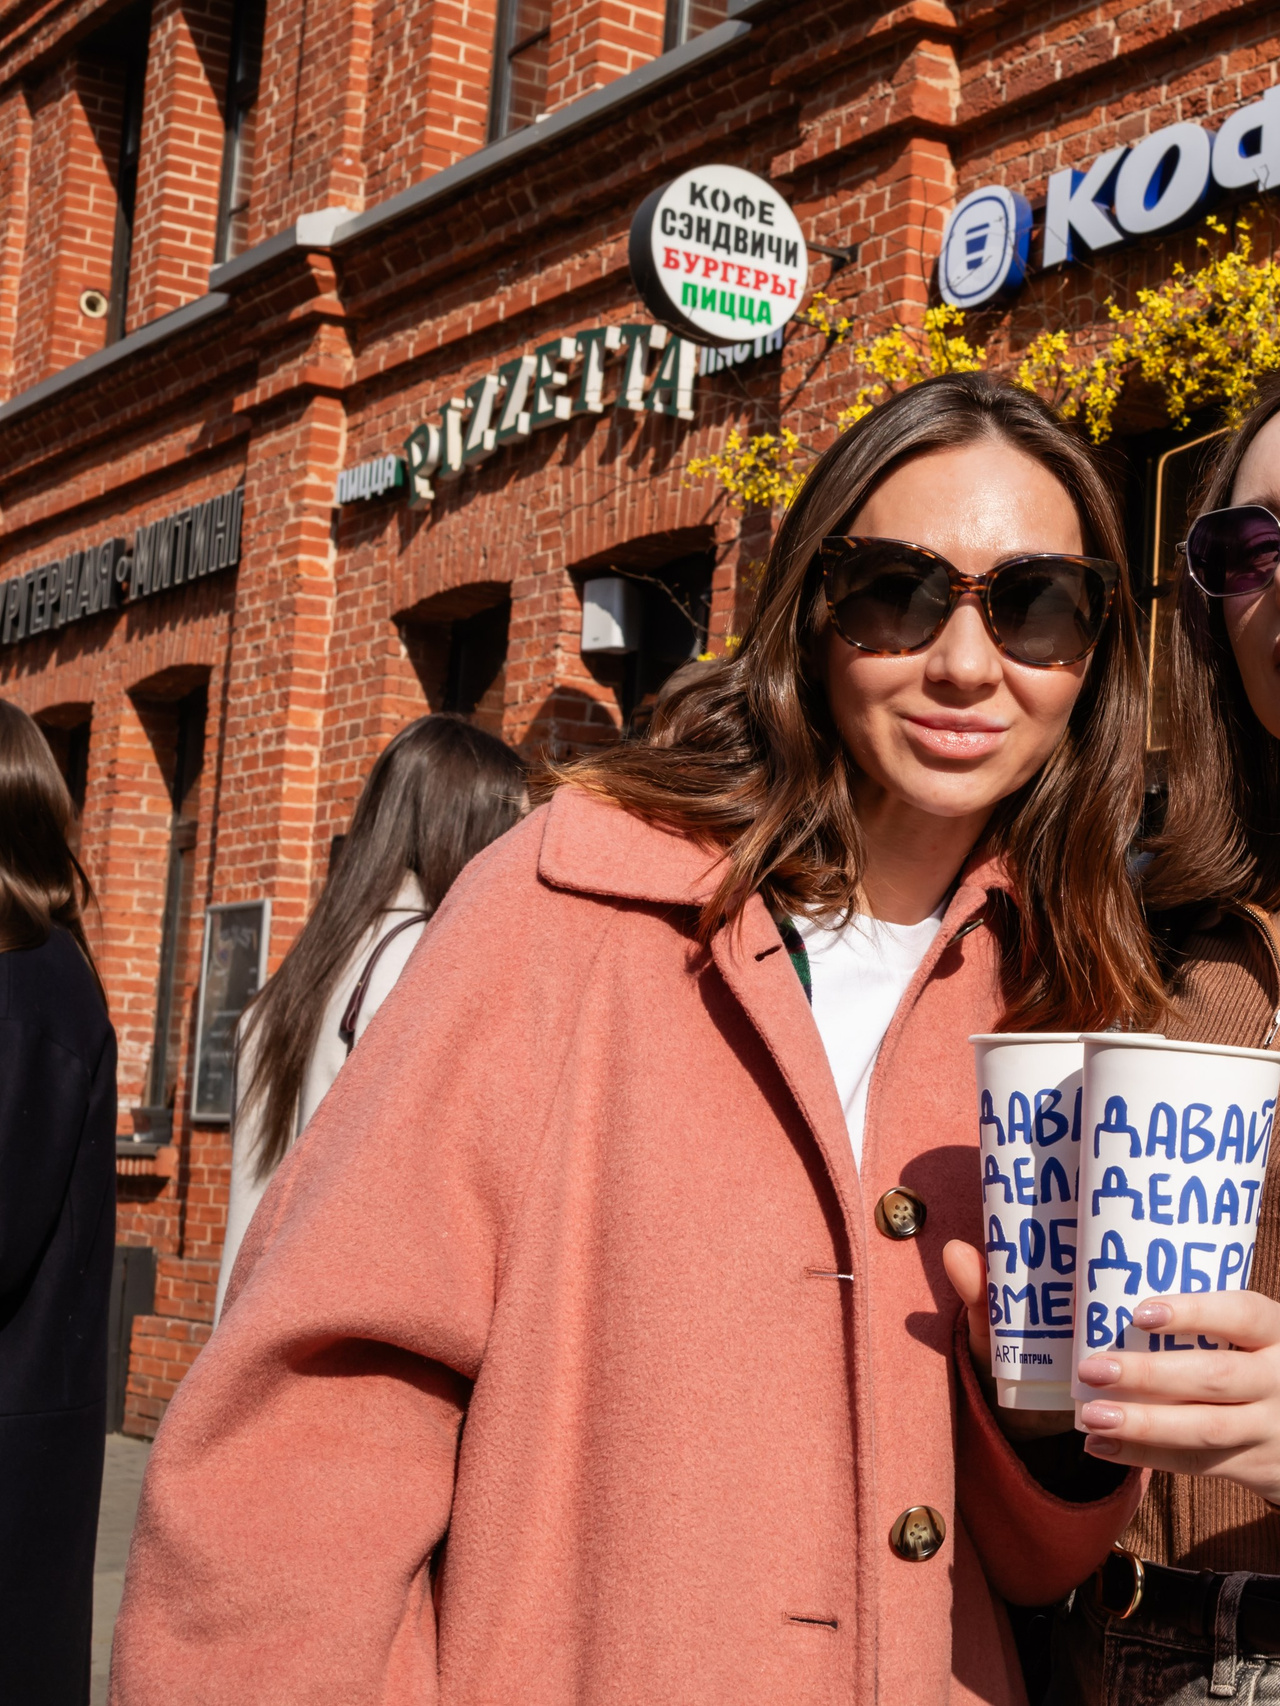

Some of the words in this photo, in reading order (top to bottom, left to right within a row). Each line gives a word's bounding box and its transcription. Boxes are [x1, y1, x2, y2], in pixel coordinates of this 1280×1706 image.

[690, 181, 775, 227] КОФЕ
[660, 208, 798, 268] СЭНДВИЧИ
[663, 246, 797, 300] БУРГЕРЫ
[681, 281, 772, 326] ПИЦЦА
[404, 323, 698, 509] PIZZETTA
[335, 453, 397, 503] ПИЦЦА
[130, 486, 245, 600] МИТИНГ
[1093, 1095, 1277, 1168] ДАВАЙ
[982, 1154, 1080, 1205] ДЕЛ
[988, 1282, 1073, 1326] ВМЕ
[995, 1344, 1019, 1363] ART
